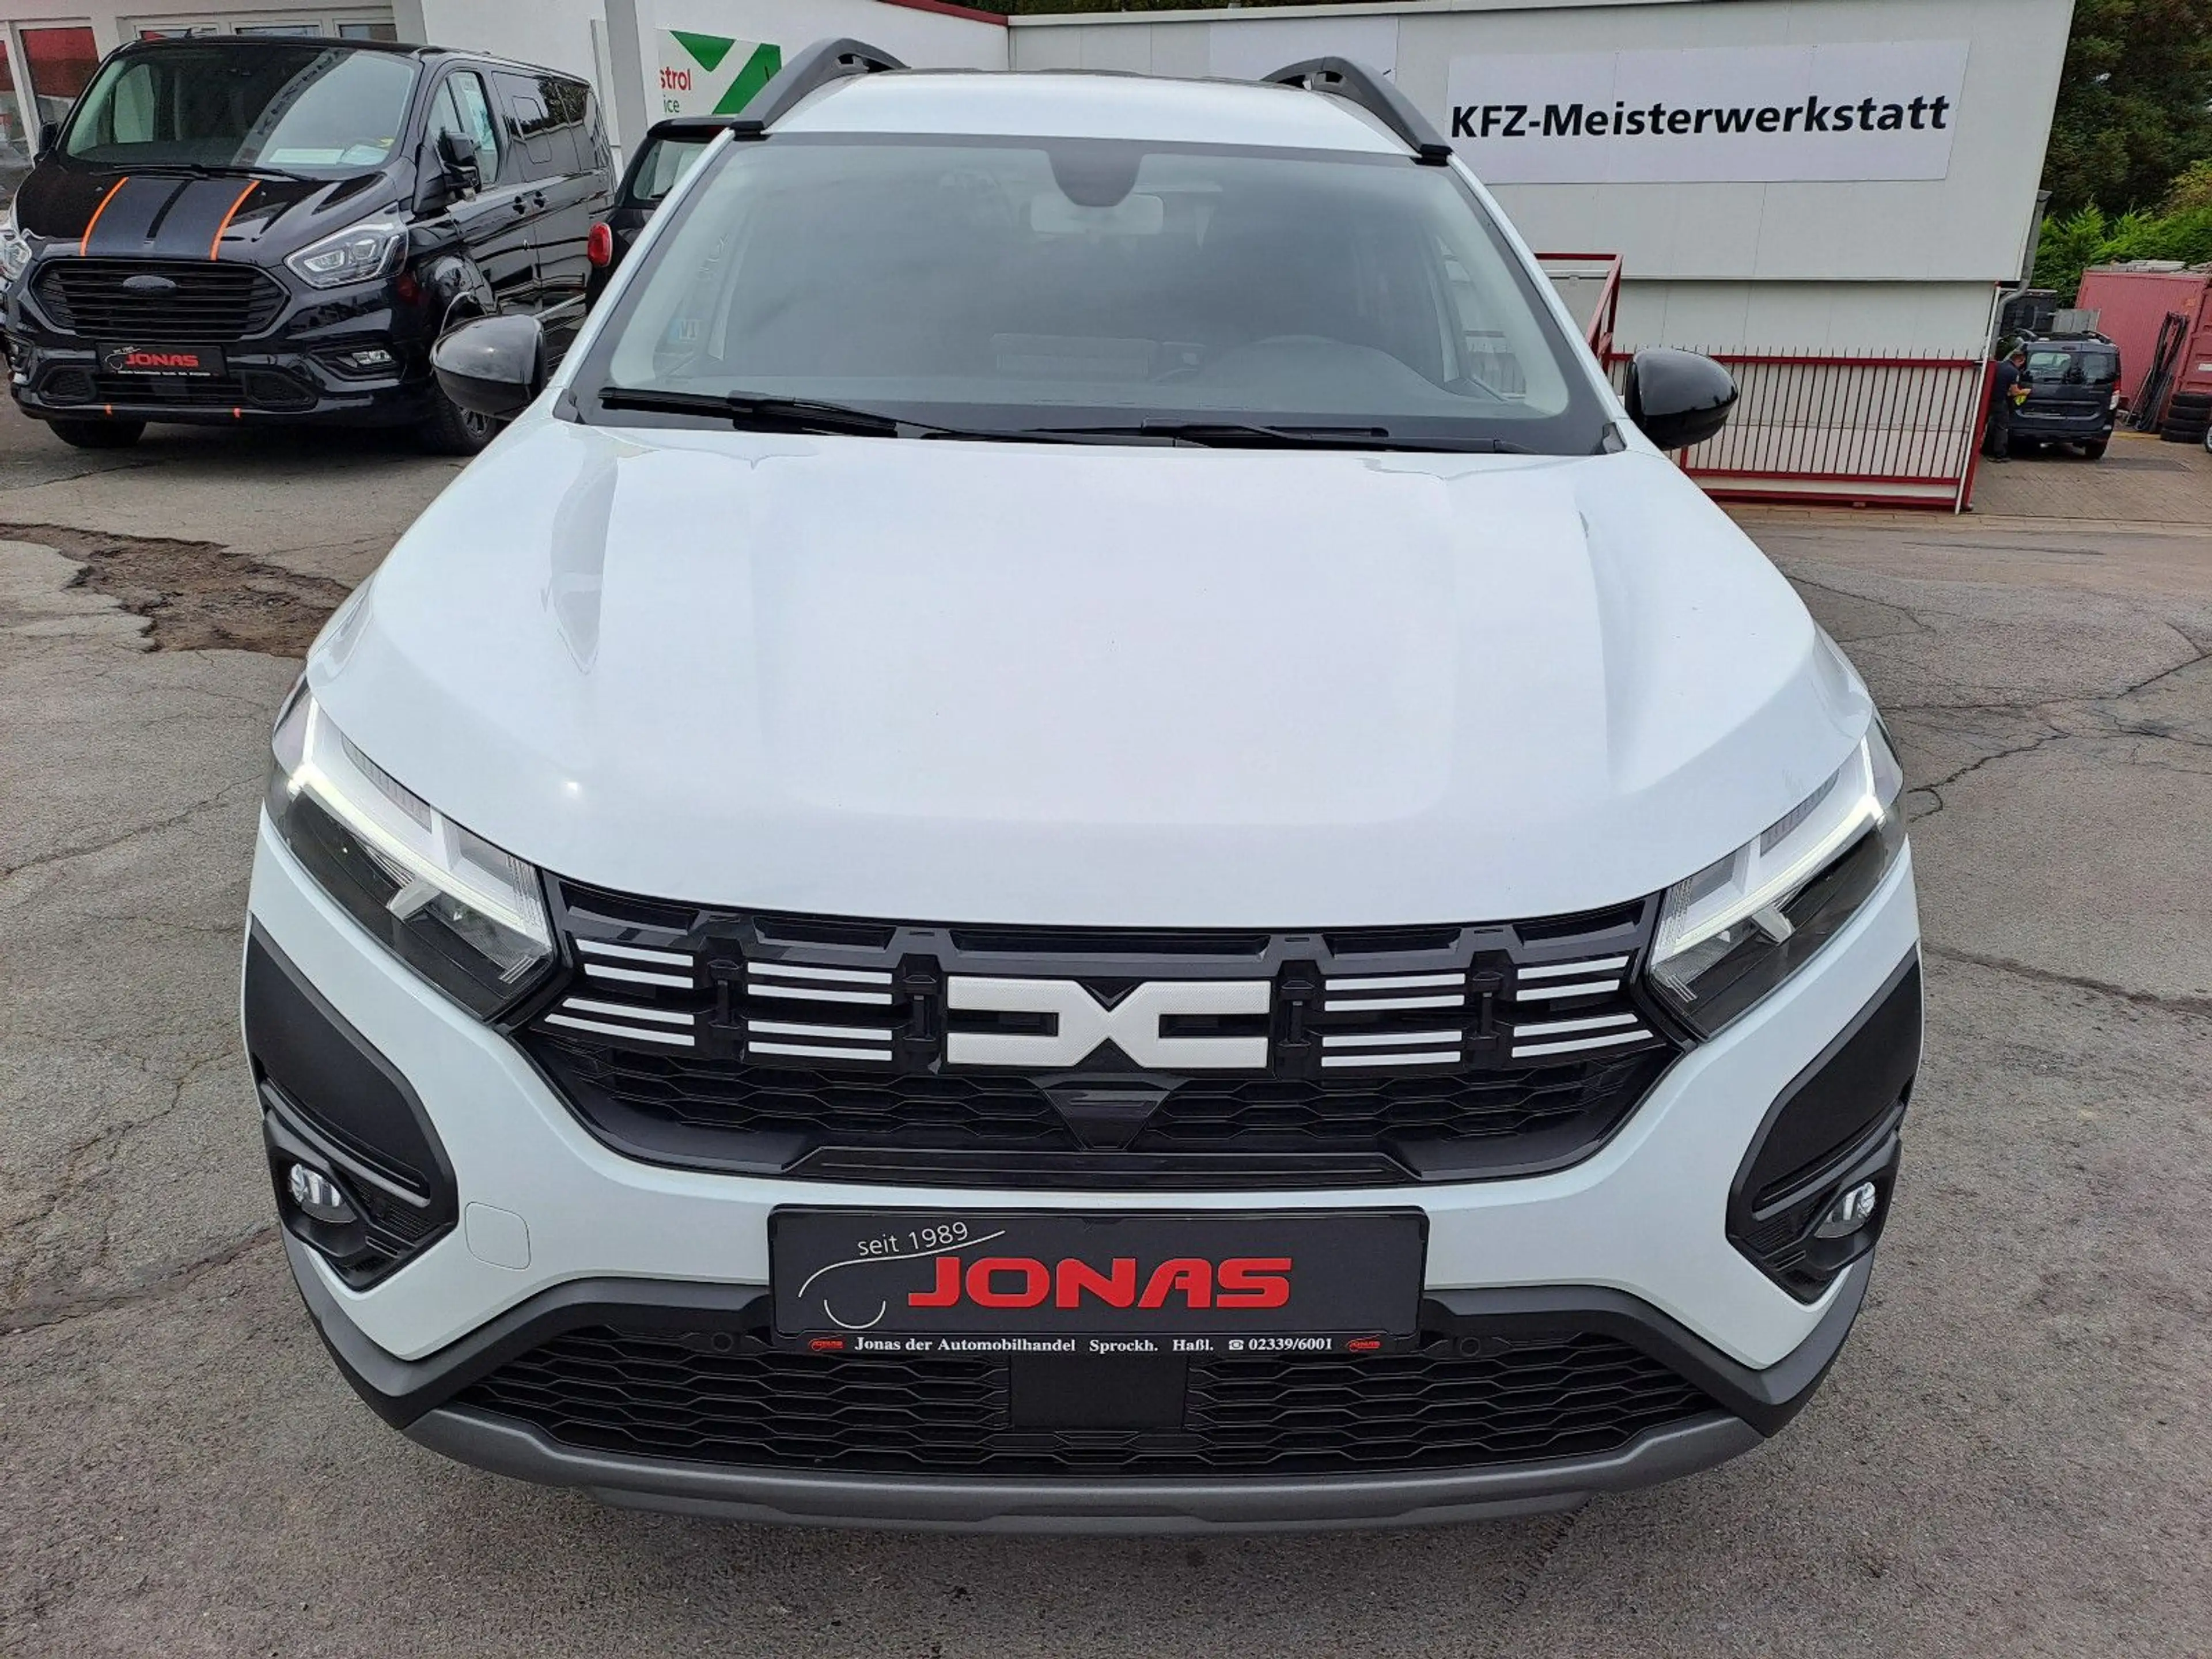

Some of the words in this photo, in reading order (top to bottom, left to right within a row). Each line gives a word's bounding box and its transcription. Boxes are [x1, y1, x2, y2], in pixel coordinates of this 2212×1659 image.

[1452, 95, 1950, 138] KFZ-Meisterwerkstatt
[124, 353, 199, 367] JONAS
[857, 1234, 899, 1256] seit
[908, 1221, 968, 1249] 1989
[908, 1256, 1292, 1308] JONAS
[854, 1336, 901, 1351] Jonas
[905, 1338, 933, 1351] der
[938, 1338, 1076, 1351] Automobilhandel
[1089, 1339, 1158, 1354] Sprockh.
[1172, 1339, 1214, 1351] Haßl.
[1248, 1338, 1332, 1351] 02339/6001
